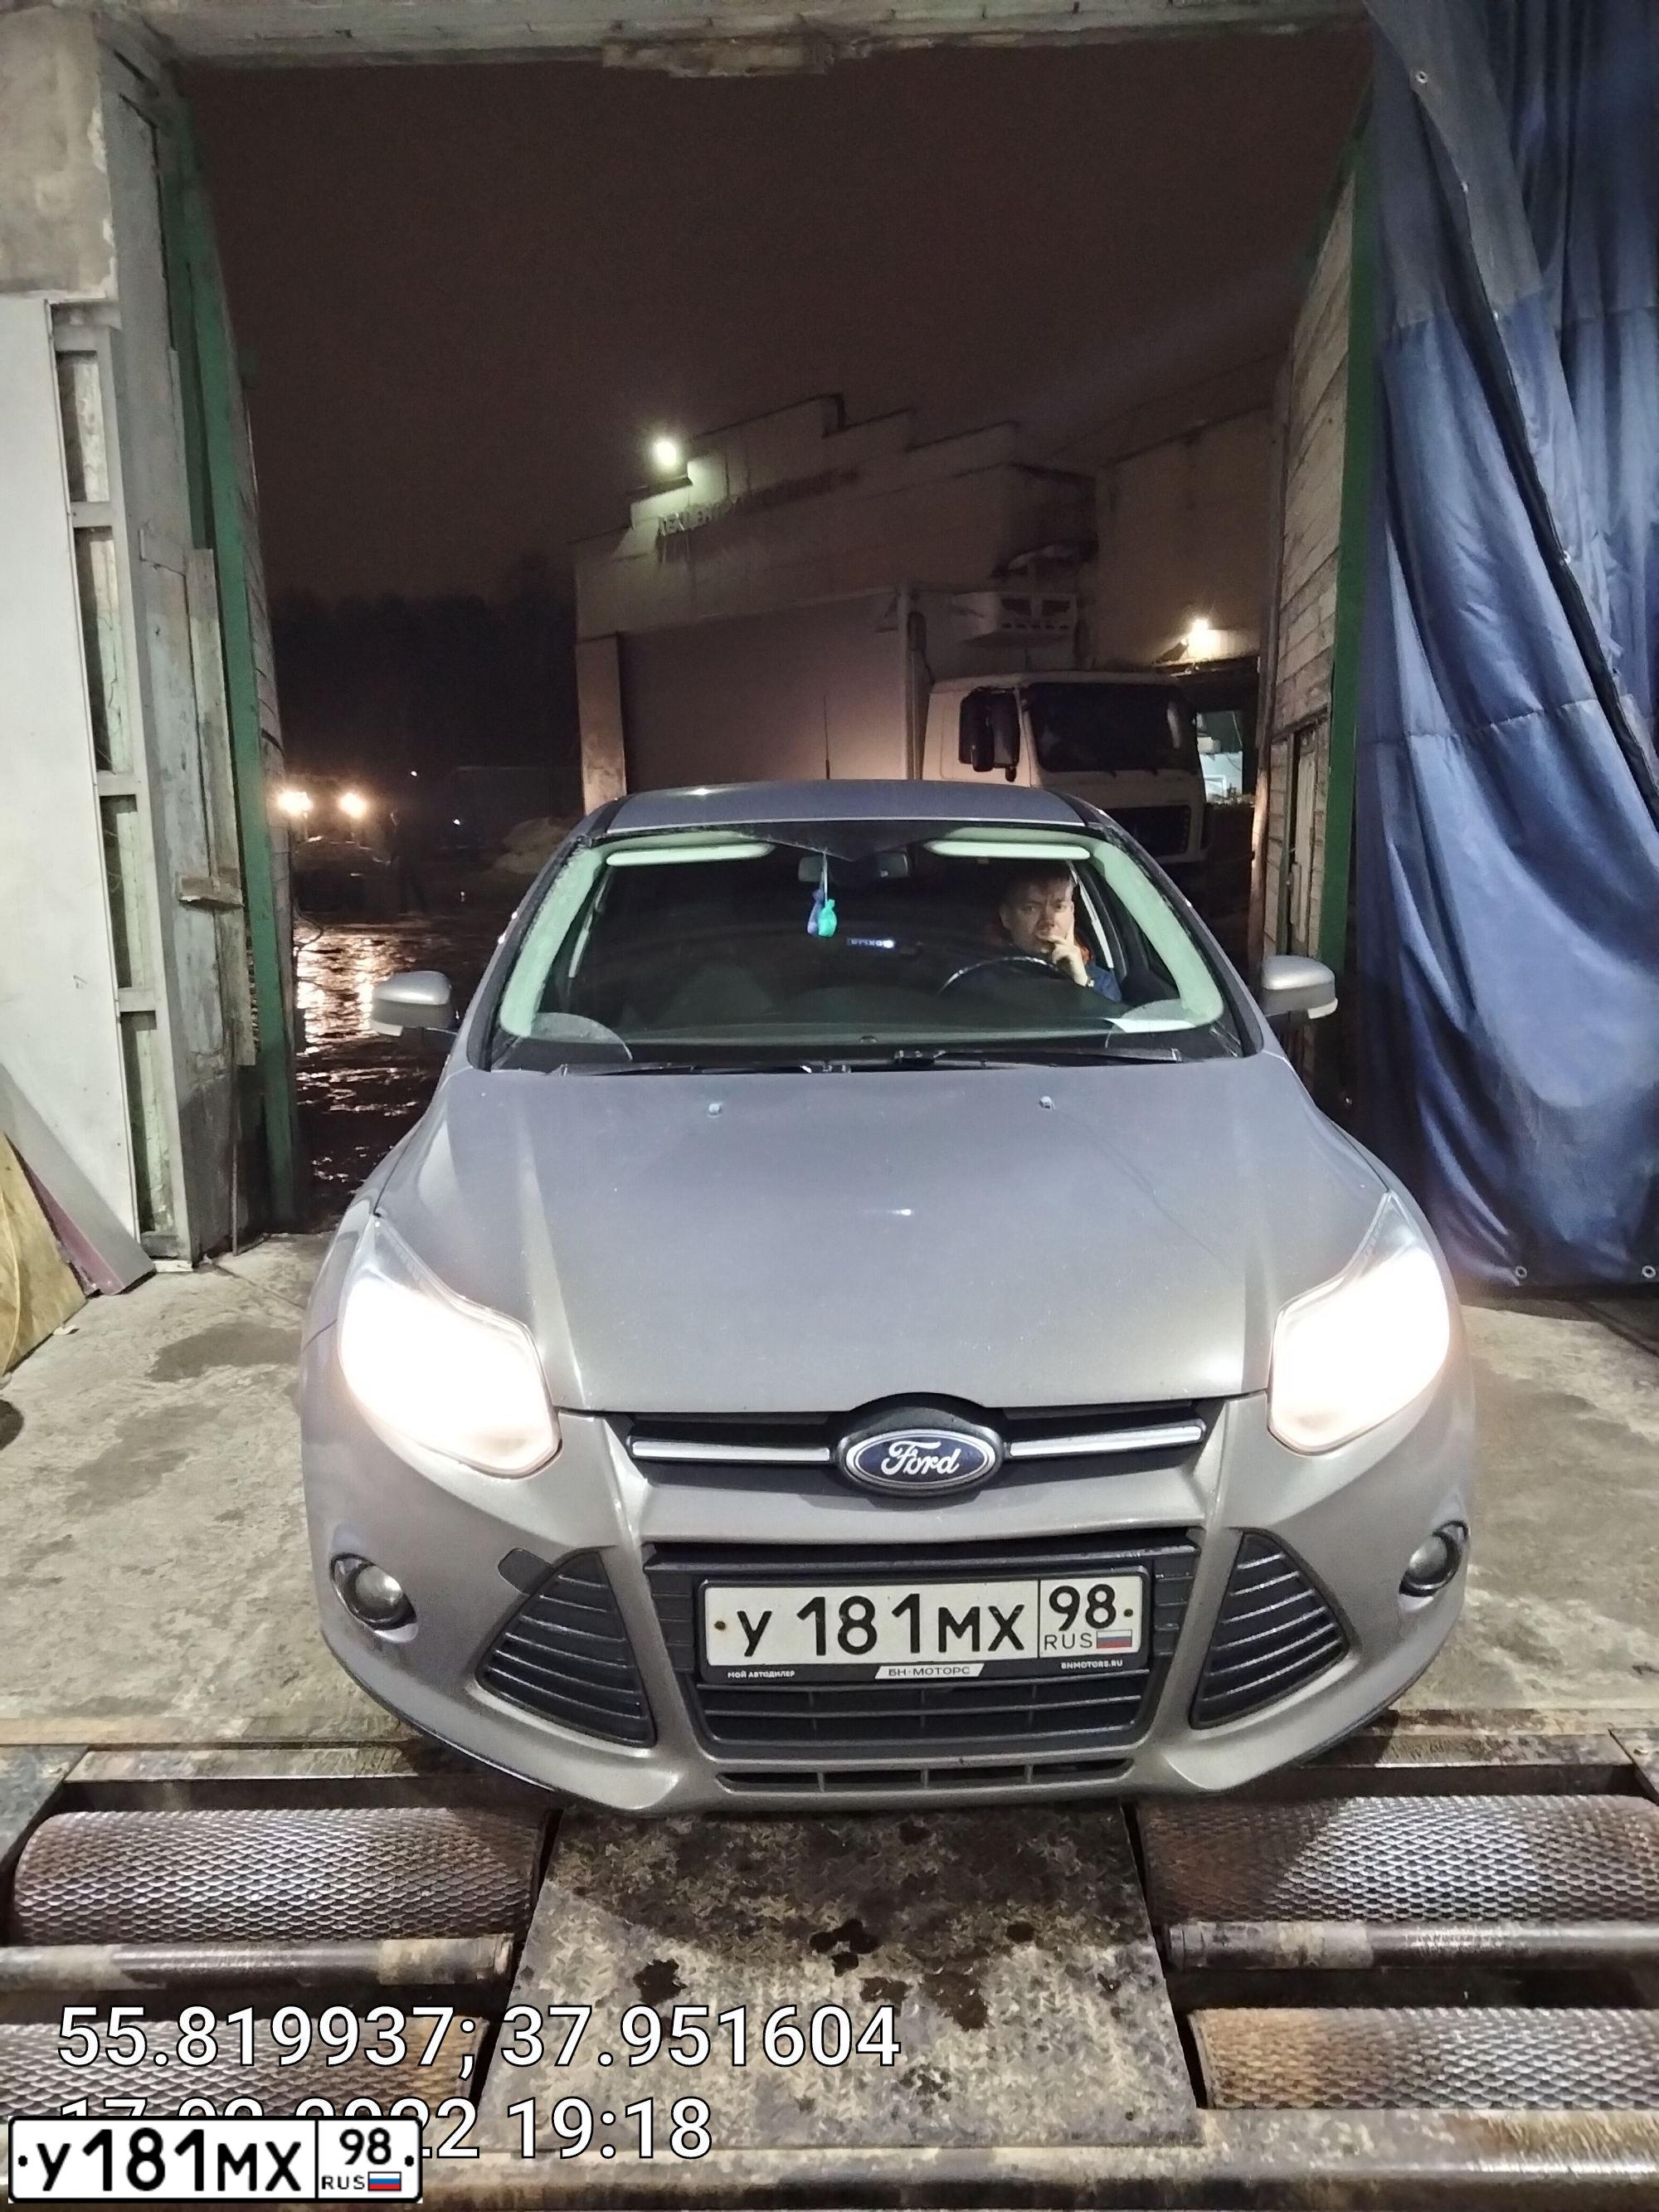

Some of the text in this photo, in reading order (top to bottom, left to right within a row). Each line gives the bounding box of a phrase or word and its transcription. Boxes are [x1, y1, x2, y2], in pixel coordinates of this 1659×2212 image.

[881, 1440, 960, 1475] Ford
[1048, 1584, 1117, 1632] 98
[1044, 1632, 1093, 1651] RUS
[727, 1670, 795, 1678] МОЙ АВТОДИЛЕР
[1062, 1659, 1123, 1670] BNMOTORS.RU
